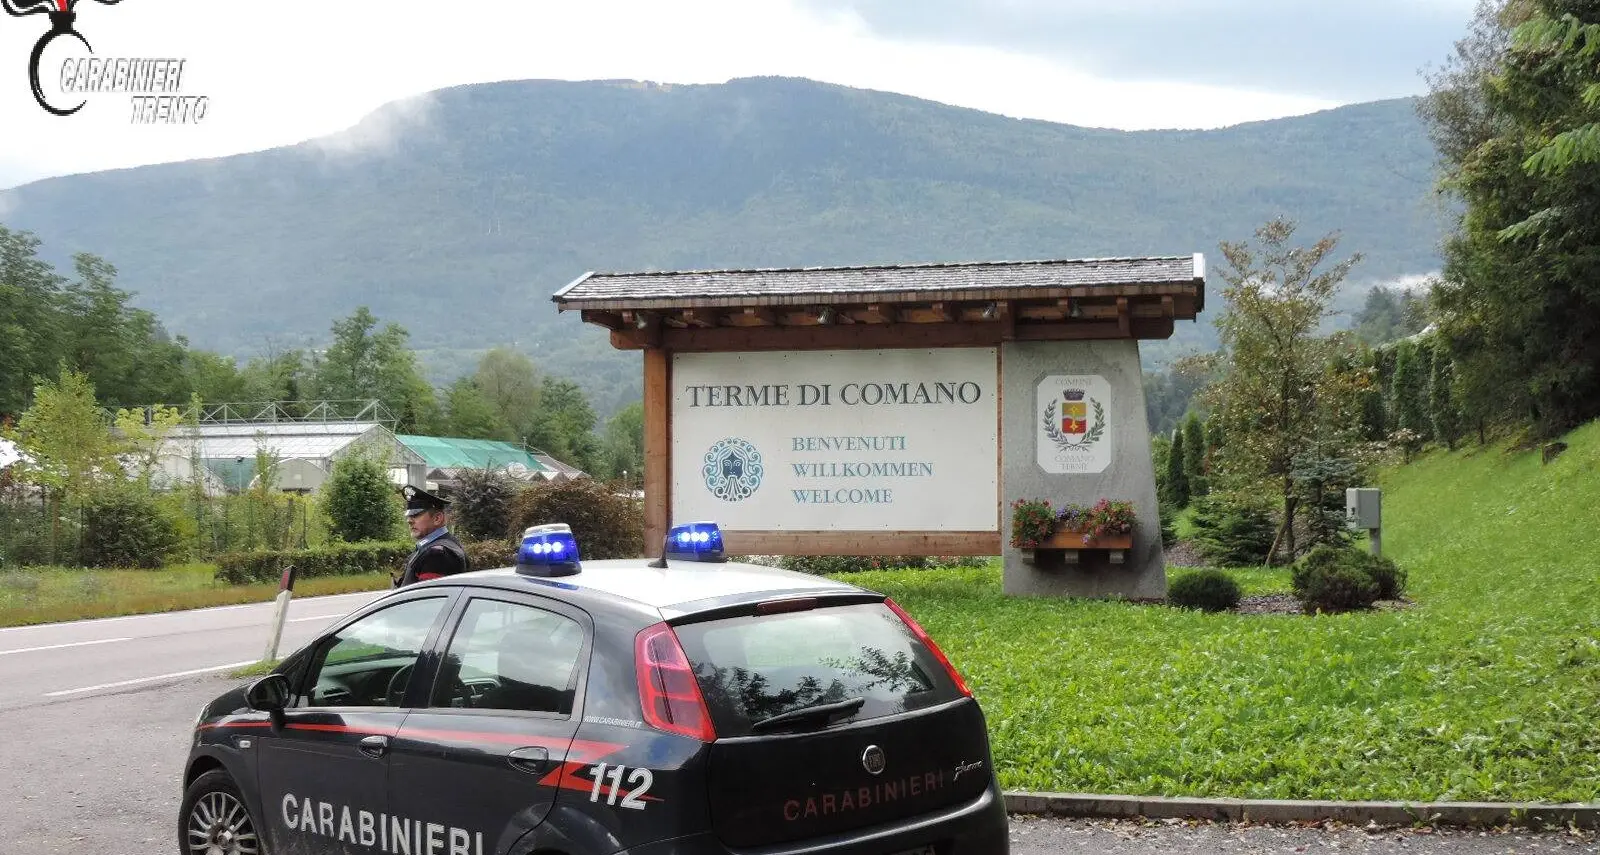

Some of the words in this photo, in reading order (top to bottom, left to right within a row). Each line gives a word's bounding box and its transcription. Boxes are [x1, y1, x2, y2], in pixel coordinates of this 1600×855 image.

[685, 383, 790, 407] TERME
[796, 384, 832, 406] DI
[838, 381, 982, 406] COMANO
[791, 435, 907, 452] BENVENUTI
[791, 462, 934, 478] WILLKOMMEN
[791, 488, 894, 504] WELCOME
[588, 762, 655, 811] 112
[783, 768, 945, 822] CARABINIERI
[281, 792, 484, 855] CARABINIERI
